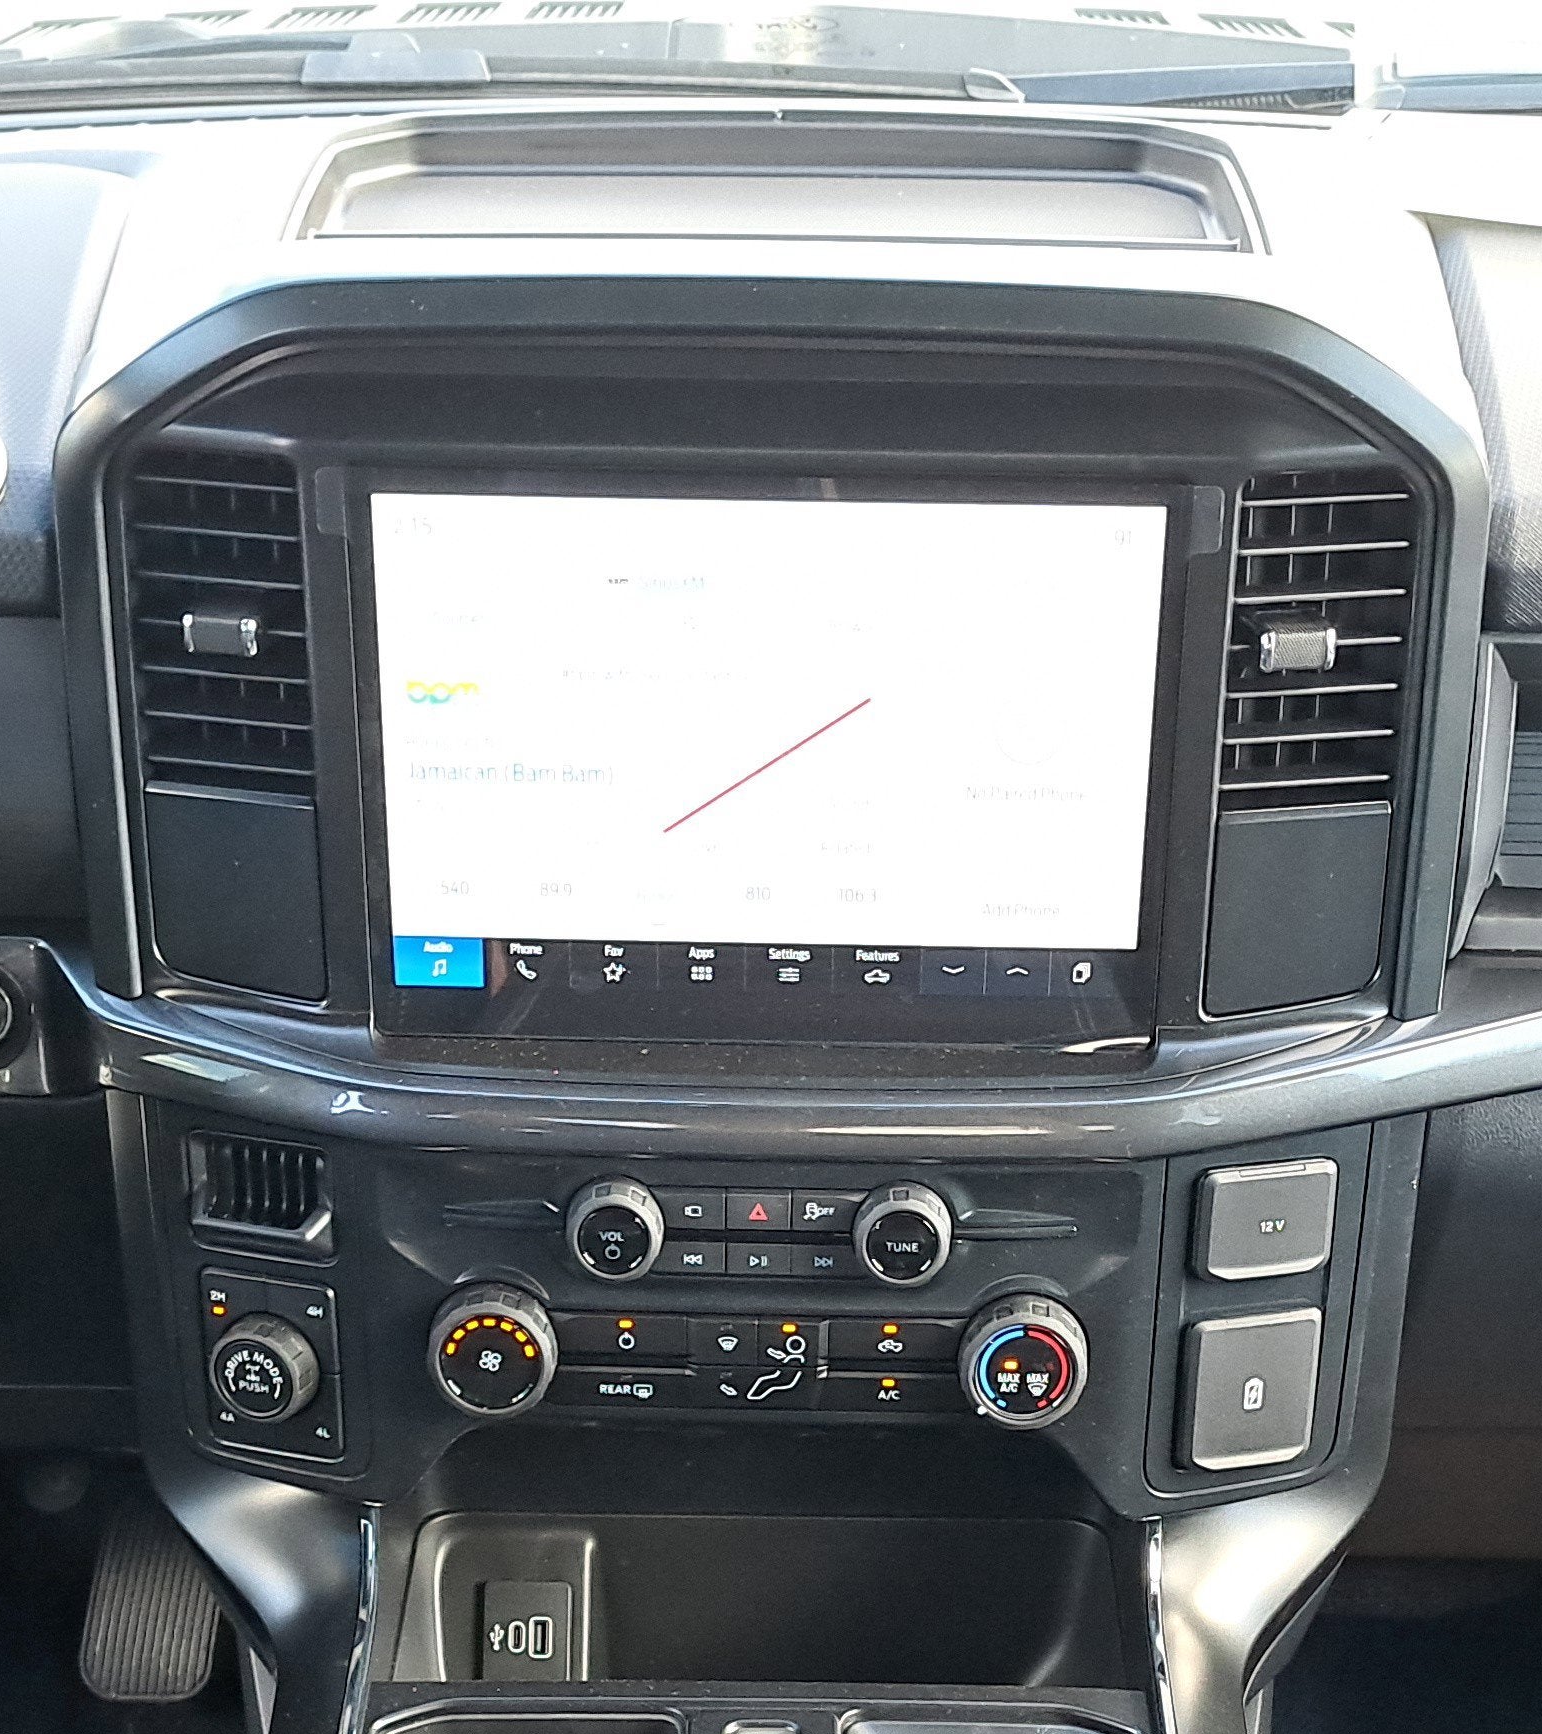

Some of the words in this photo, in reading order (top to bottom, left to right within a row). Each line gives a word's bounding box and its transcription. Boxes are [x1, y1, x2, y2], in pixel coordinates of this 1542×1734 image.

[423, 941, 453, 953] Audio
[509, 943, 543, 956] Phone
[688, 946, 715, 960] Apps
[768, 947, 811, 962] Settings
[855, 949, 900, 962] Features
[599, 1230, 625, 1243] VOL
[886, 1241, 919, 1254] TUNE
[210, 1290, 226, 1302] 2H
[224, 1350, 251, 1379] DRIVE
[253, 1351, 283, 1384] MODE
[997, 1372, 1021, 1383] MAX
[1026, 1372, 1049, 1383] MAX
[238, 1379, 270, 1394] PUSH
[599, 1384, 631, 1396] REAR
[877, 1389, 901, 1401] A/C
[219, 1411, 235, 1423] 4A
[315, 1426, 331, 1439] 4L
